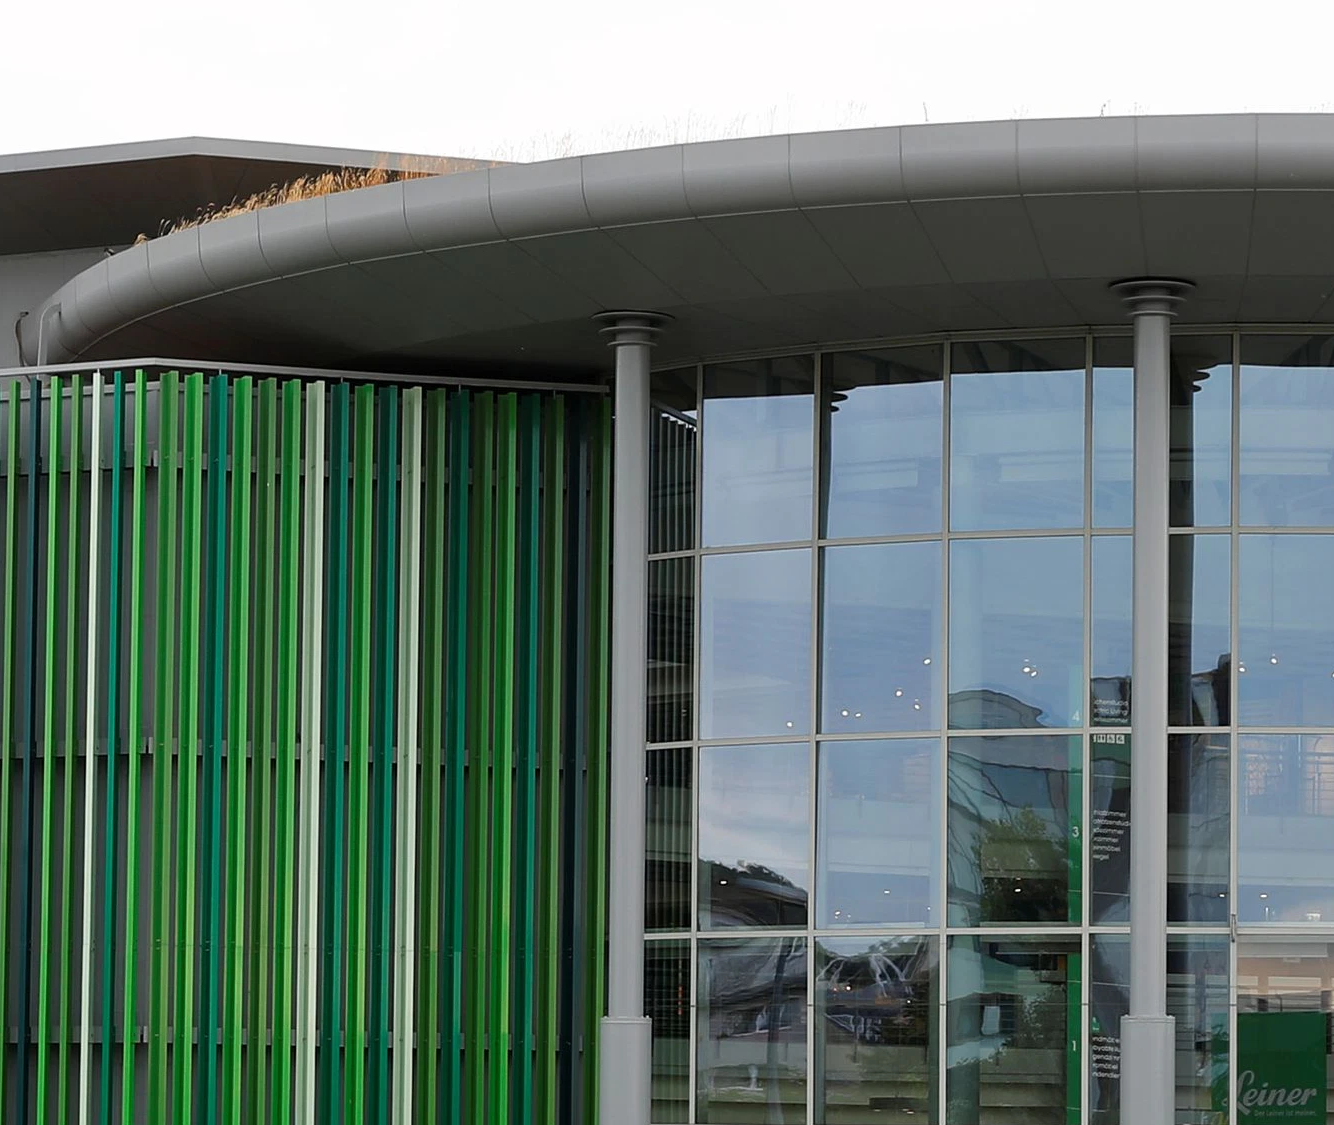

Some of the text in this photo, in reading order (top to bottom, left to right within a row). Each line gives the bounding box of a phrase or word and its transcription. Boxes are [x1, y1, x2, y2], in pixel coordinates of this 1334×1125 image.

[1072, 710, 1080, 721] 4
[1072, 826, 1080, 838] 3
[1072, 1040, 1077, 1051] 1
[1221, 1070, 1318, 1116] Leiner
